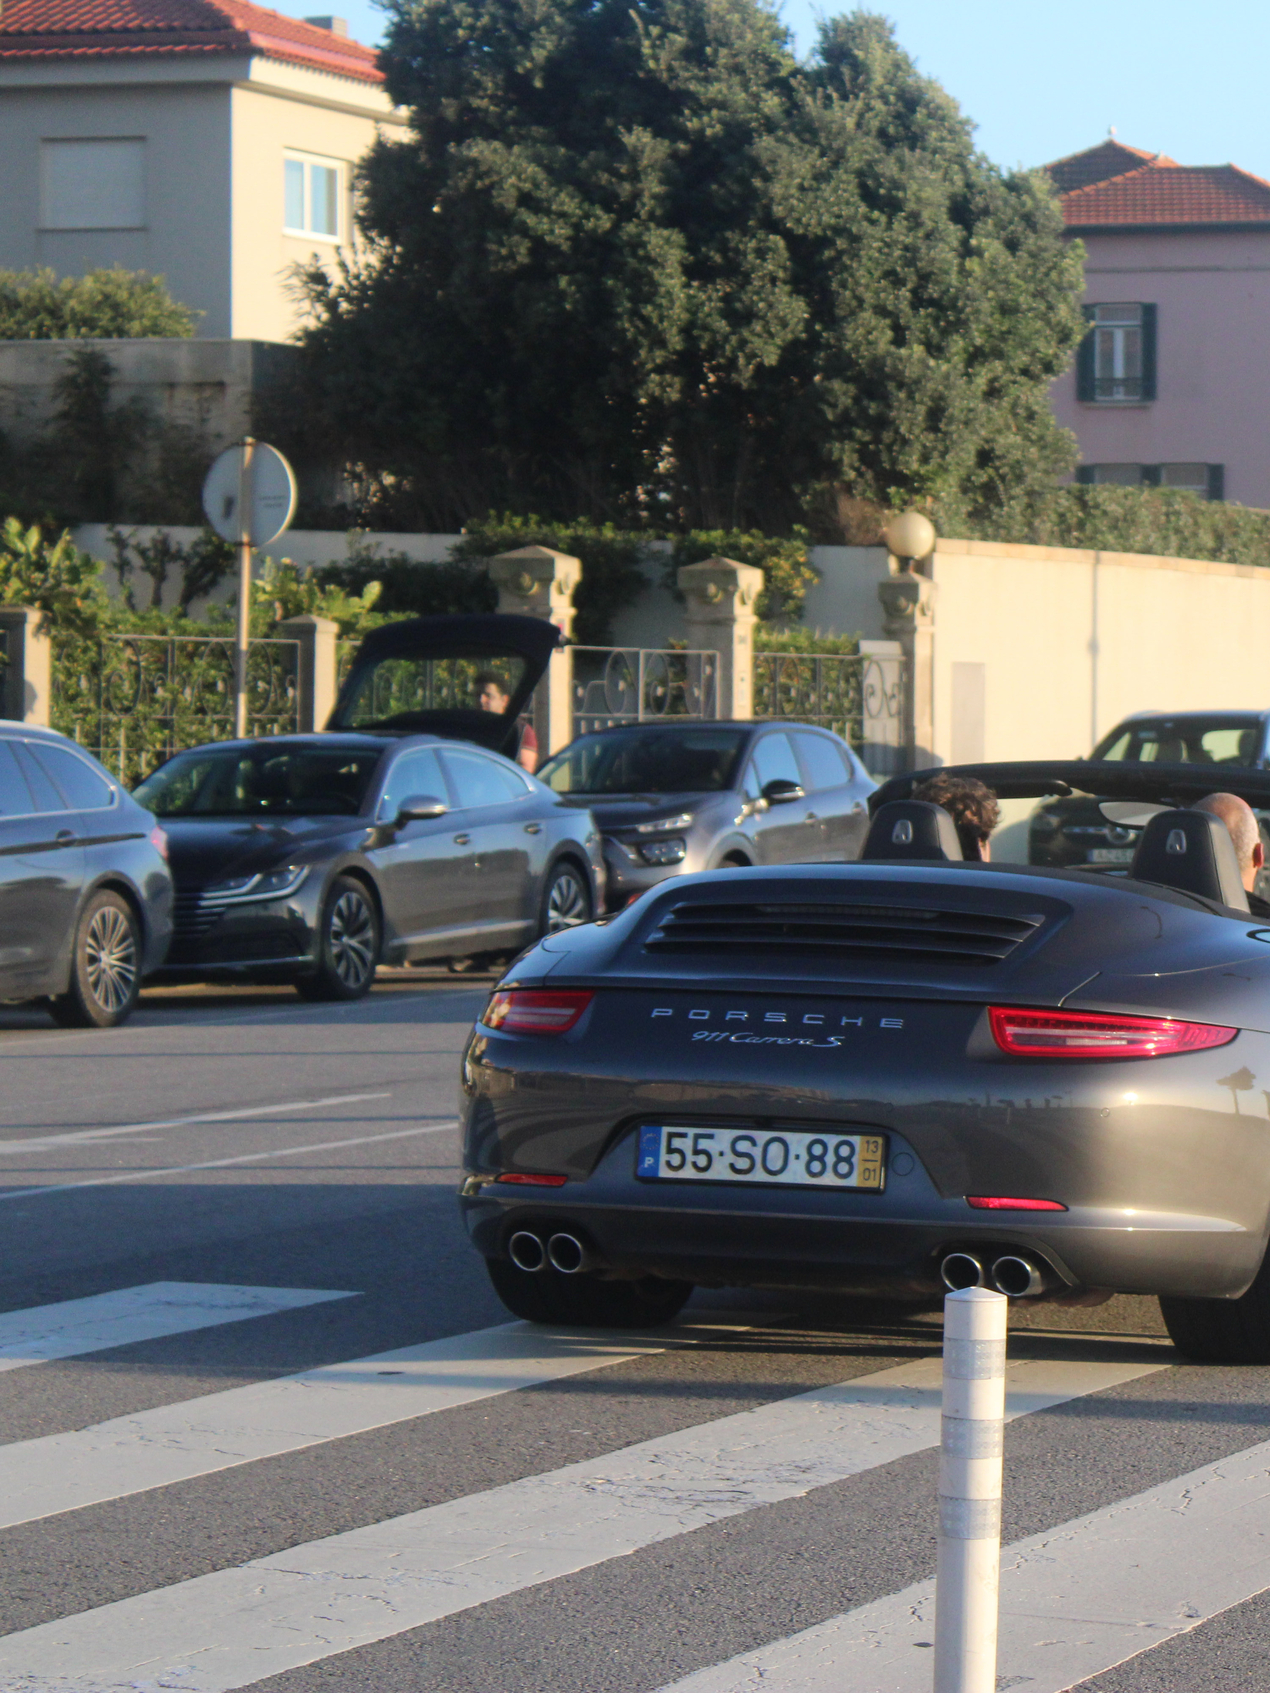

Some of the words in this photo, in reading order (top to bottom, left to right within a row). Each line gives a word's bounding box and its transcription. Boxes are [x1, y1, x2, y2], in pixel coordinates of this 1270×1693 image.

[651, 1008, 904, 1029] PORSCHE
[692, 1031, 730, 1042] 911
[729, 1032, 814, 1046] Carrera
[812, 1036, 845, 1048] S
[865, 1140, 879, 1154] 13
[644, 1157, 655, 1168] P
[862, 1168, 877, 1181] 01
